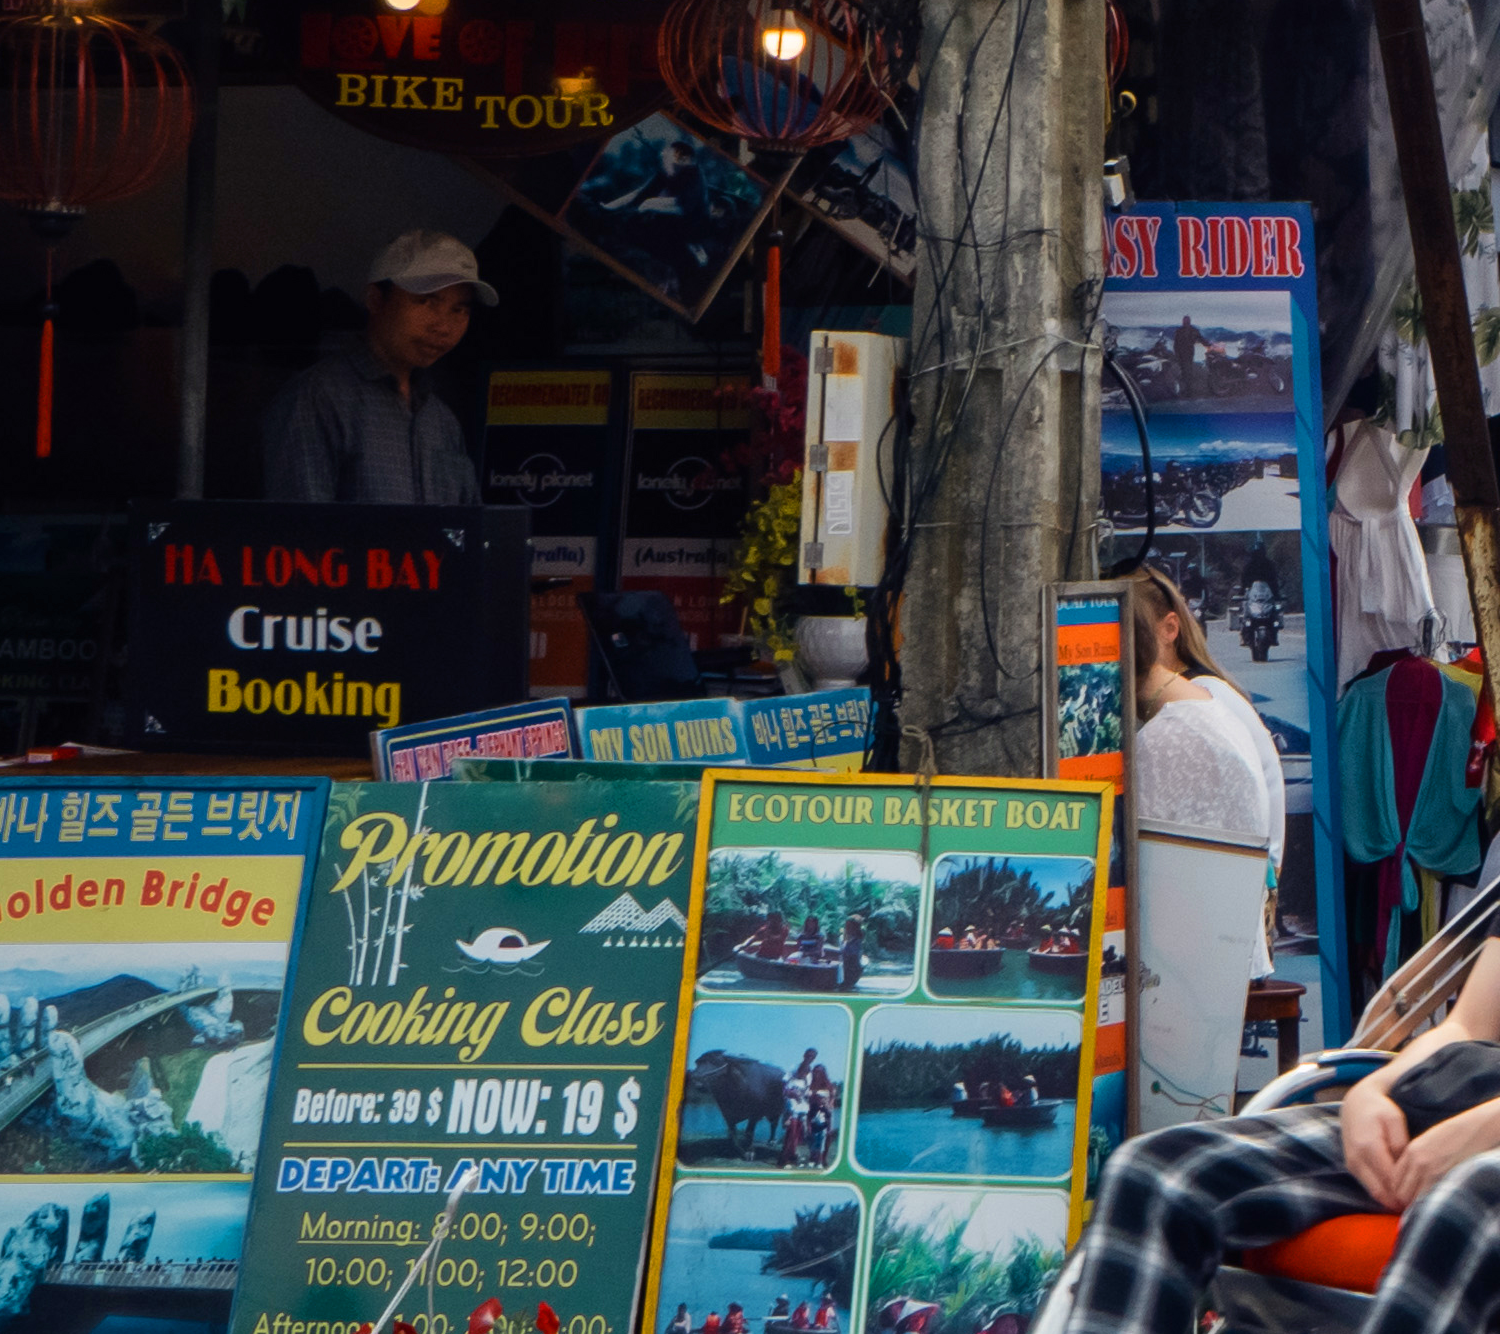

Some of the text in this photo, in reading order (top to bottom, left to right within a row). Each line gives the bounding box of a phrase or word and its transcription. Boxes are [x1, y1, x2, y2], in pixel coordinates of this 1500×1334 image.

[334, 73, 616, 131] BIKE TOUR
[1176, 215, 1306, 280] RIDER
[489, 469, 595, 493] lonely planet
[163, 544, 447, 594] HA LONG BAY
[225, 606, 385, 656] Cruise
[205, 669, 404, 730] Booking
[589, 716, 739, 763] MY SON RUINS
[750, 709, 784, 753] 바나
[780, 706, 811, 750] 힐즈
[807, 702, 839, 746] 골든
[58, 792, 121, 843] 힐즈
[129, 792, 195, 844] 골든
[200, 790, 302, 843] 브릿지
[728, 792, 1087, 832] ECOTOUR BASKET BOAT
[329, 811, 686, 895] Promotion
[139, 870, 278, 928] Bridge
[301, 984, 667, 1065] Cooking Class
[291, 1087, 385, 1125] Before:
[426, 1087, 444, 1128] $
[445, 1077, 554, 1136] NOW:
[560, 1079, 606, 1136] 19
[613, 1075, 643, 1141] $
[275, 1156, 638, 1197] DEPART: ANY TIME
[299, 1210, 423, 1246] Morning:
[518, 1212, 598, 1245] 9:00;
[305, 1257, 395, 1291] 10:00;
[499, 1258, 579, 1289] 12:00
